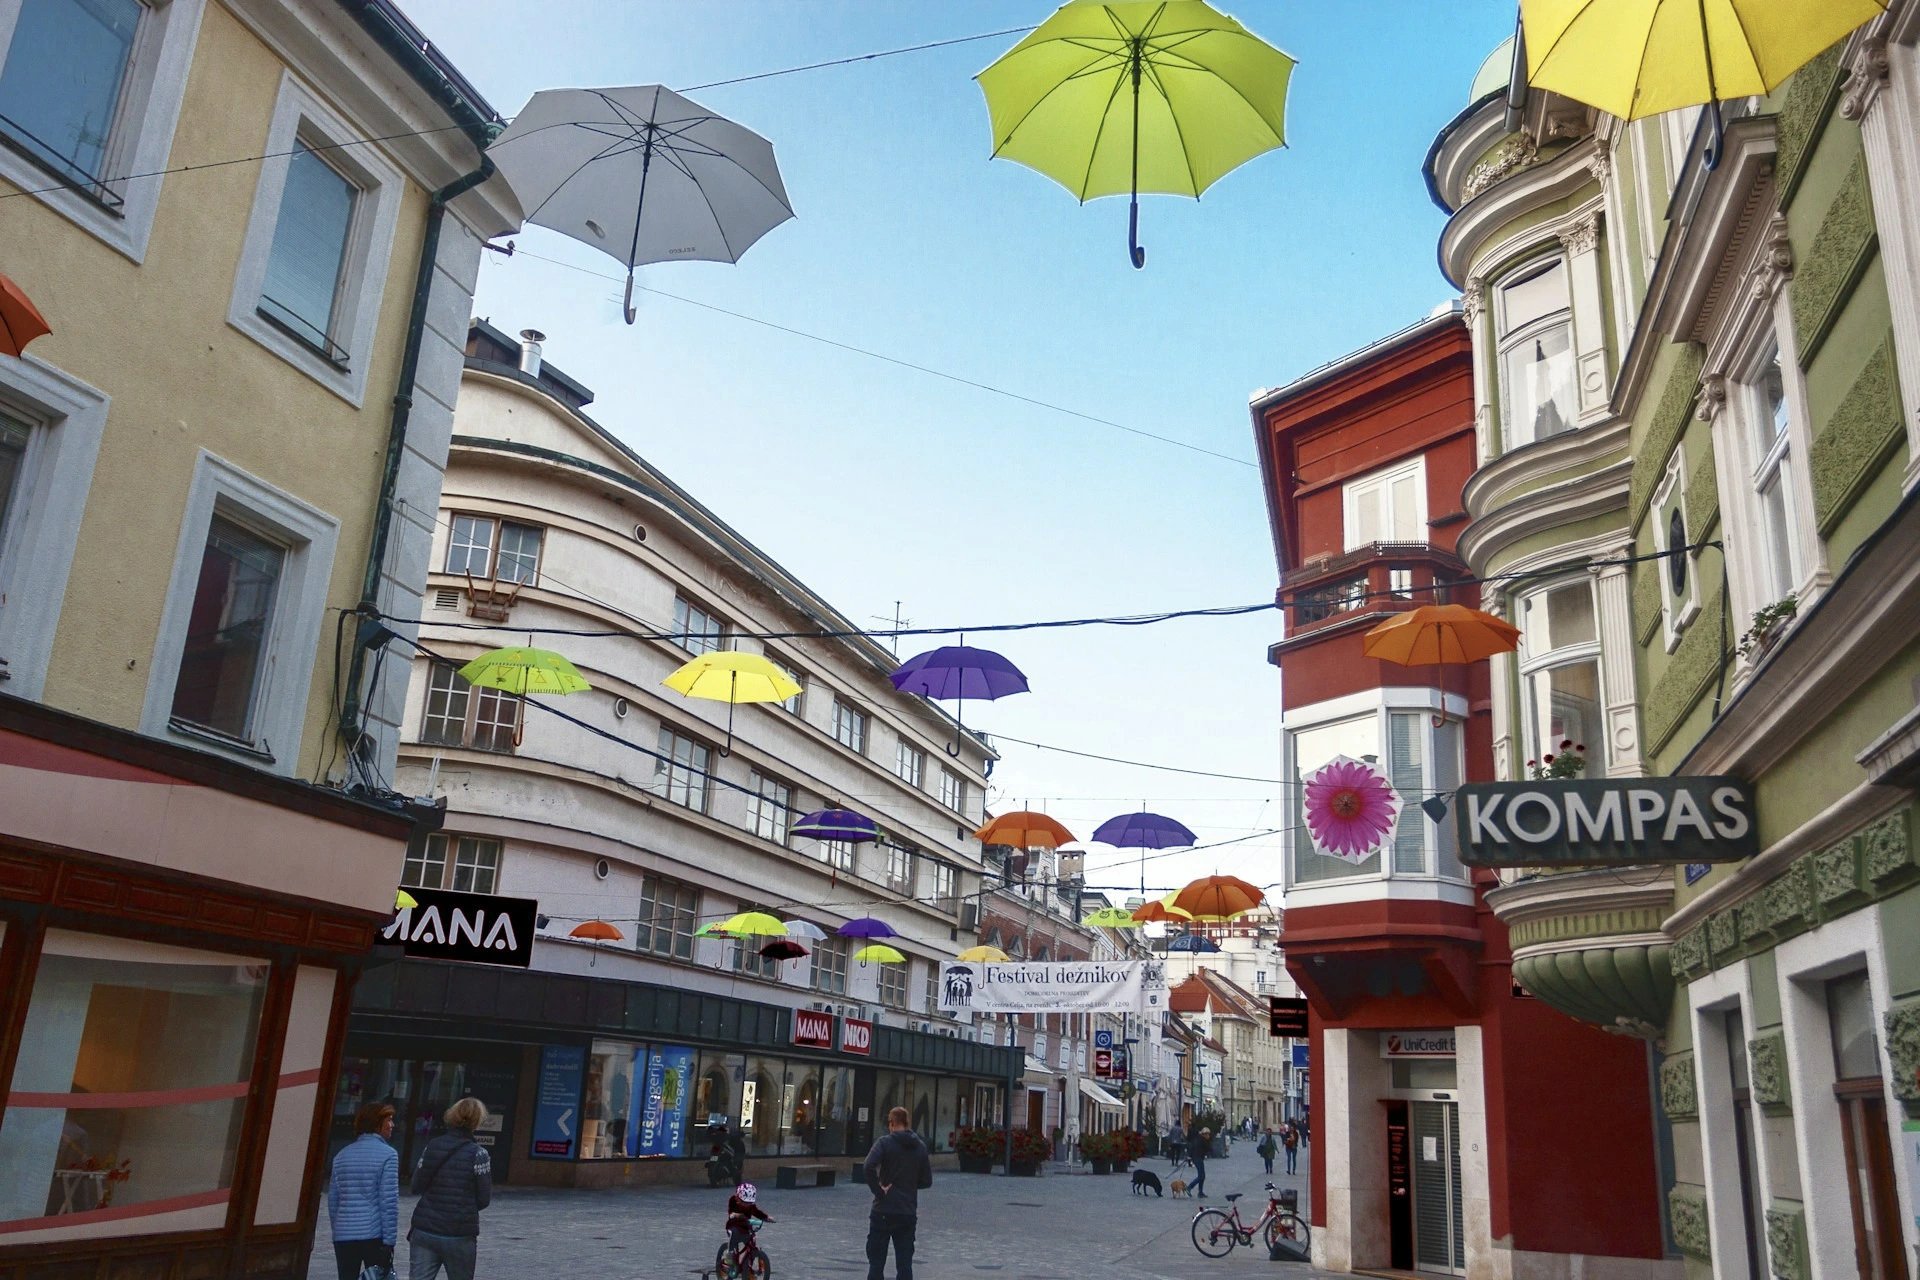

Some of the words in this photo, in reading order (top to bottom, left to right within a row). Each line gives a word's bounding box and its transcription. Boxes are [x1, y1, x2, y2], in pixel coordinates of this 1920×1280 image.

[1467, 787, 1749, 843] KOMPAS
[986, 966, 1049, 984] Festival
[1056, 965, 1131, 984] dežnikov
[796, 1018, 829, 1040] MANA
[844, 1023, 870, 1048] NKD
[1404, 1038, 1448, 1051] UniCredit
